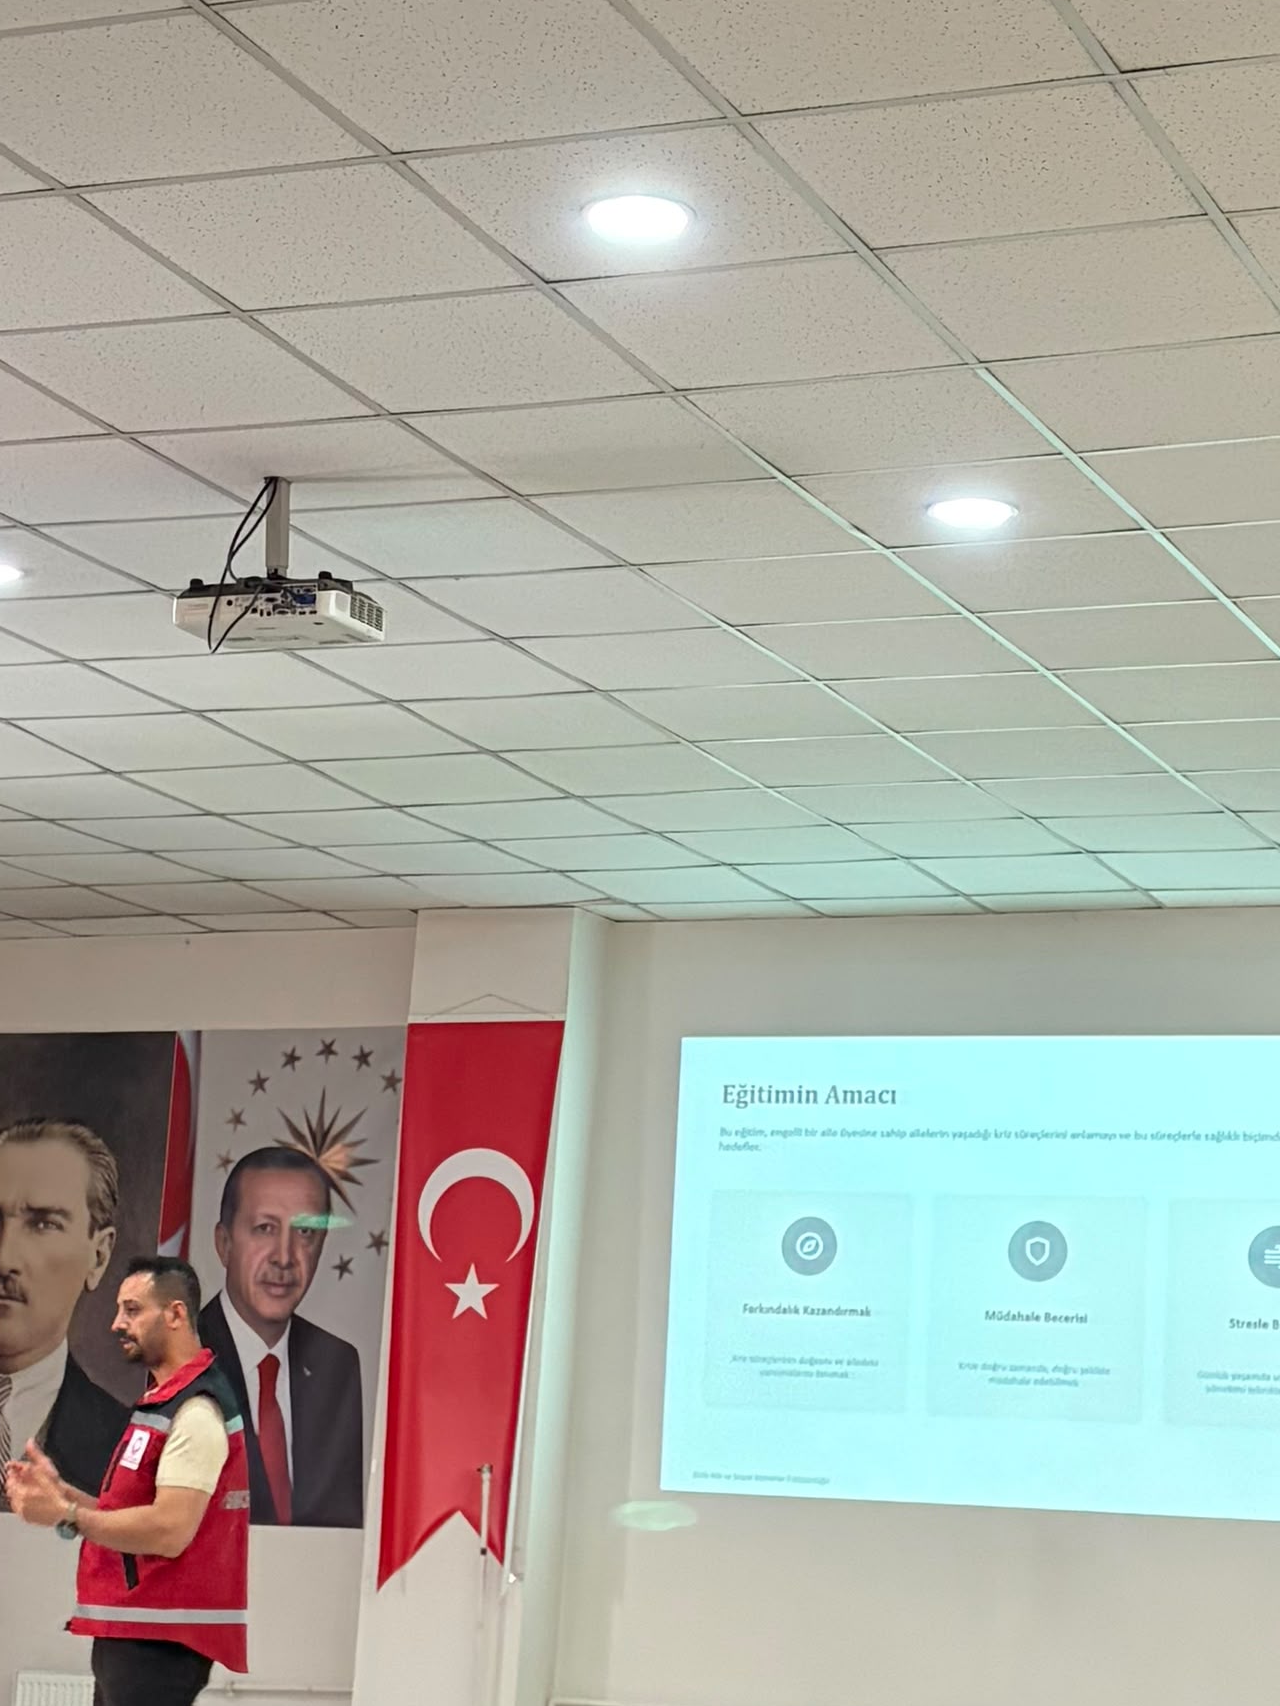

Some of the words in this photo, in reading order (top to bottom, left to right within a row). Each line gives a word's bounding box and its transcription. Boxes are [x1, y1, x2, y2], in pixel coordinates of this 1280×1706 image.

[722, 1084, 818, 1109] Eğitimin
[824, 1085, 897, 1105] Amacı
[742, 1303, 800, 1315] Farkındalık
[803, 1305, 871, 1317] Kazandırmak
[984, 1310, 1041, 1322] Müdahale
[1044, 1312, 1088, 1324] Becerisi
[1228, 1318, 1269, 1329] Stresle
